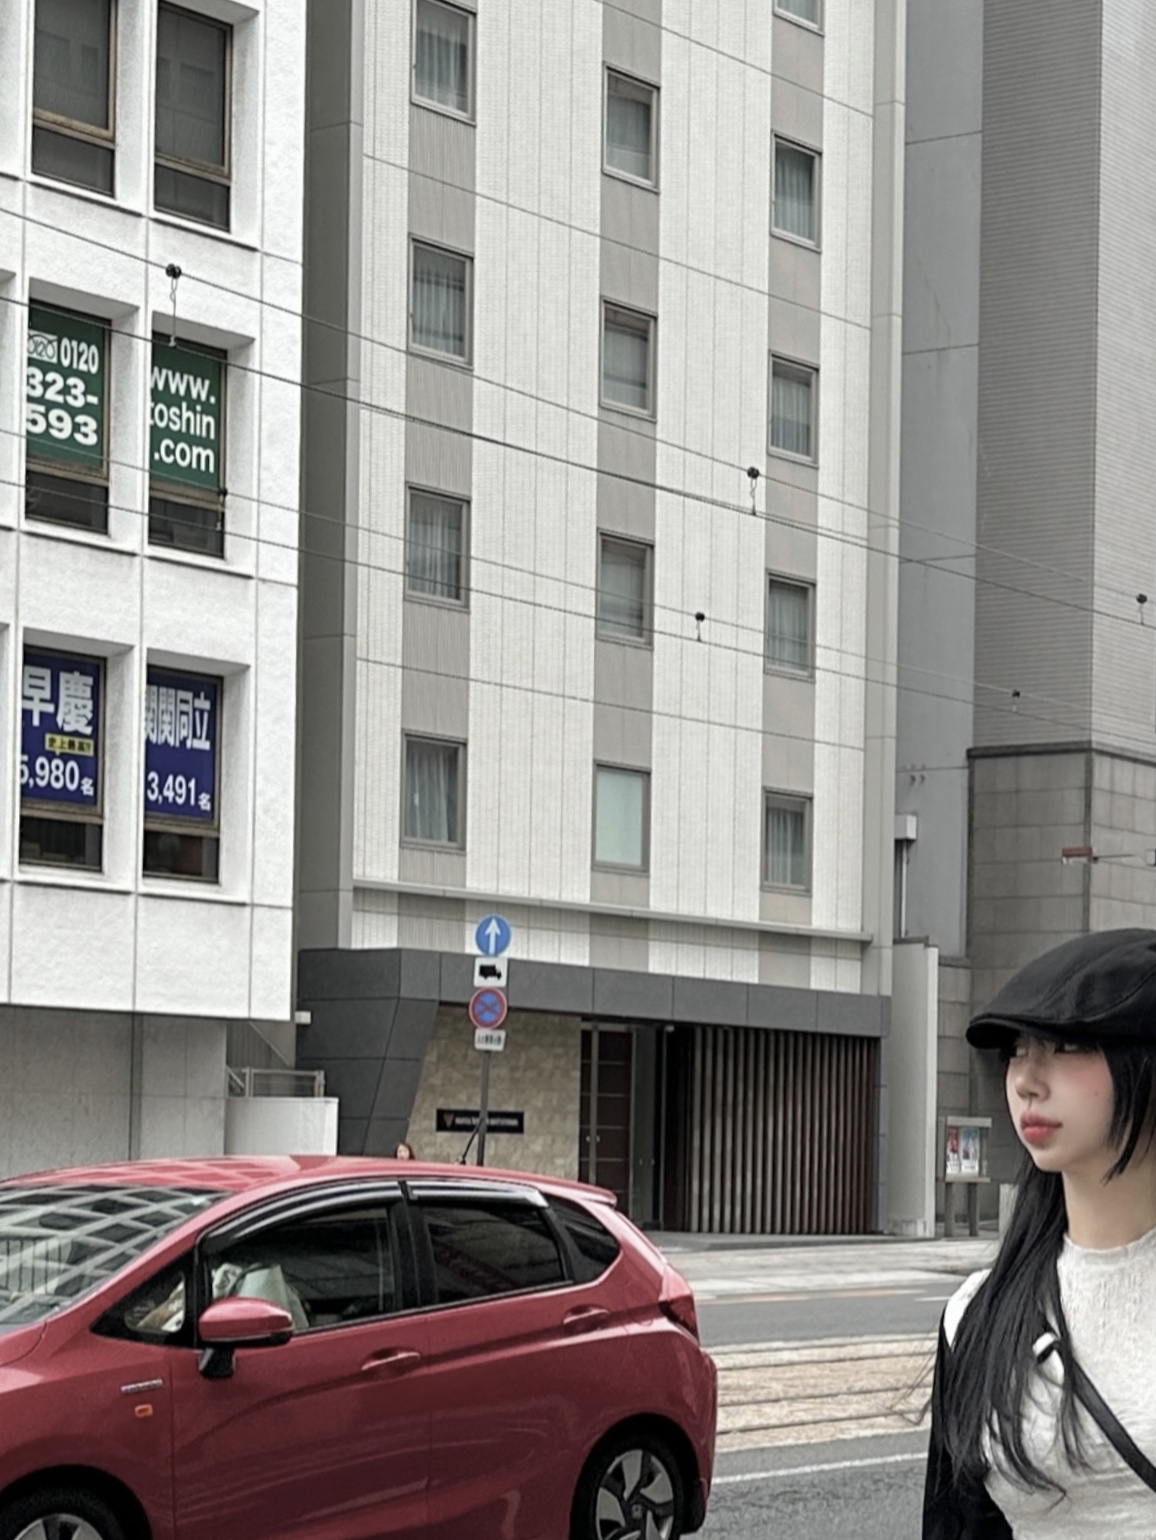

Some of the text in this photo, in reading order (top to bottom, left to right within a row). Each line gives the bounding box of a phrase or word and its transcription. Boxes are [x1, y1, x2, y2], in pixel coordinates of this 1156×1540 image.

[60, 337, 99, 374] 0120
[27, 366, 99, 408] 323-
[151, 366, 216, 404] www.
[26, 401, 98, 446] 593
[154, 438, 215, 474] .com
[22, 666, 93, 735] 早慶
